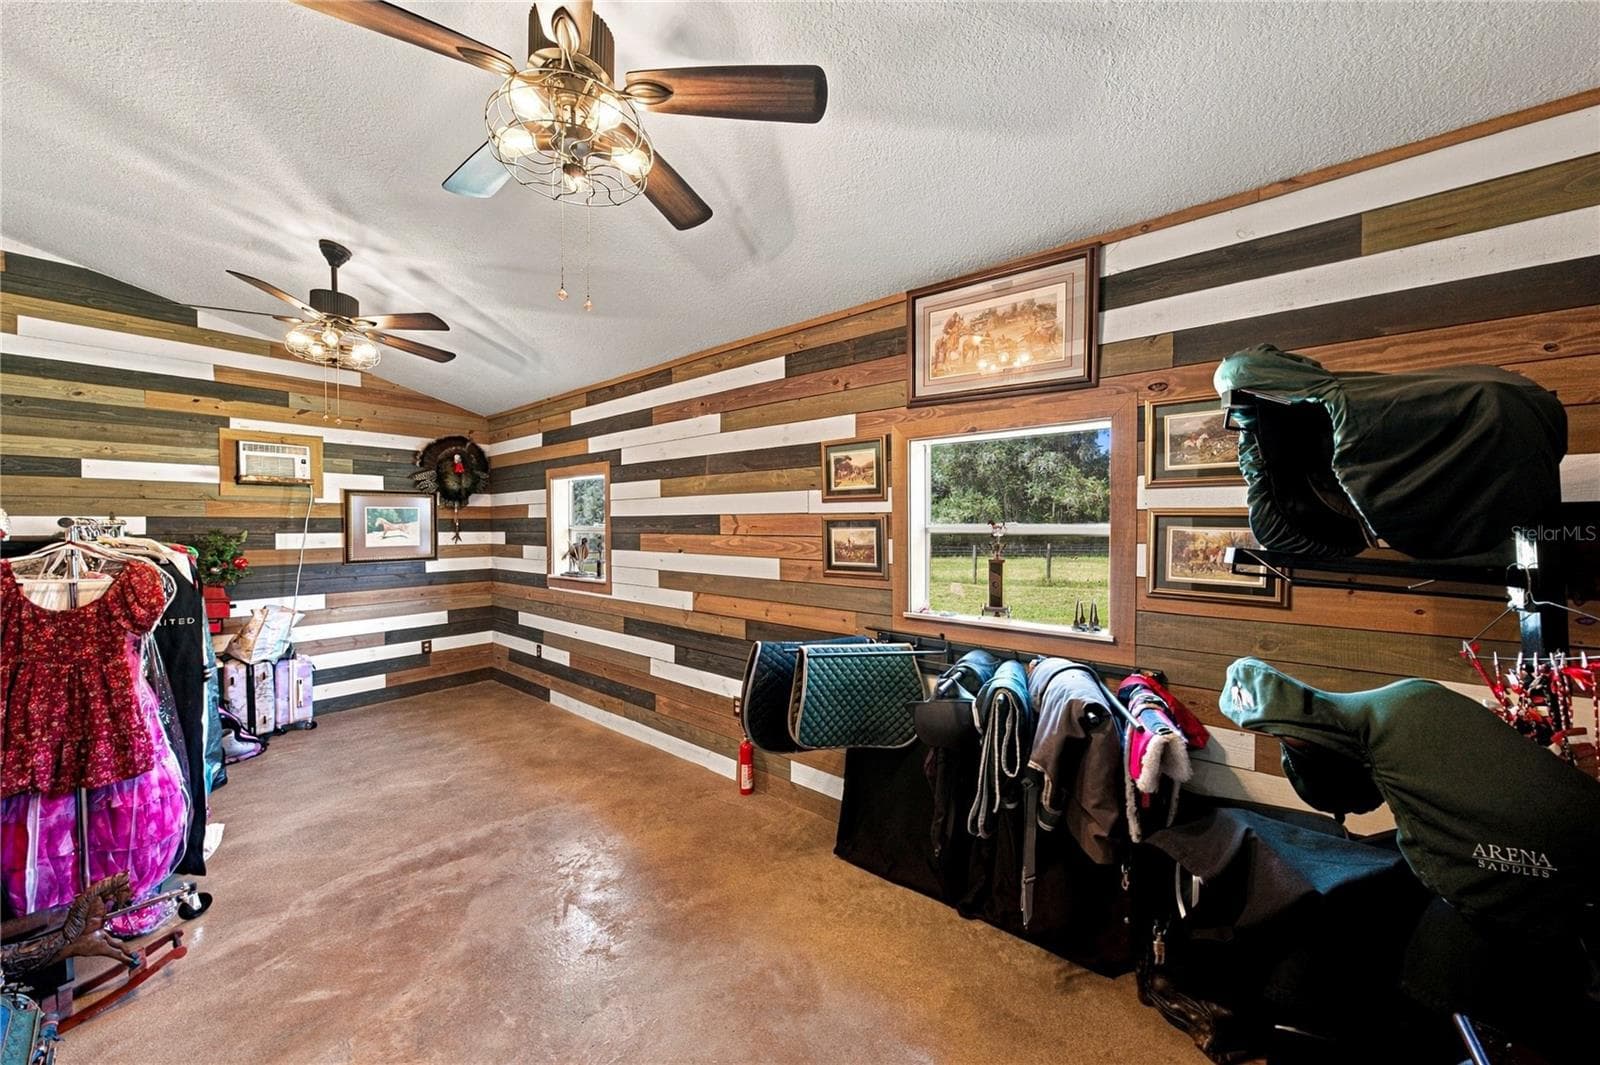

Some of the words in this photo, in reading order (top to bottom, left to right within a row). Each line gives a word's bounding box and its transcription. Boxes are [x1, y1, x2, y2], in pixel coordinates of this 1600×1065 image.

[158, 617, 196, 627] ITED
[1472, 843, 1552, 868] ARENA
[1478, 859, 1550, 879] SADDLES
